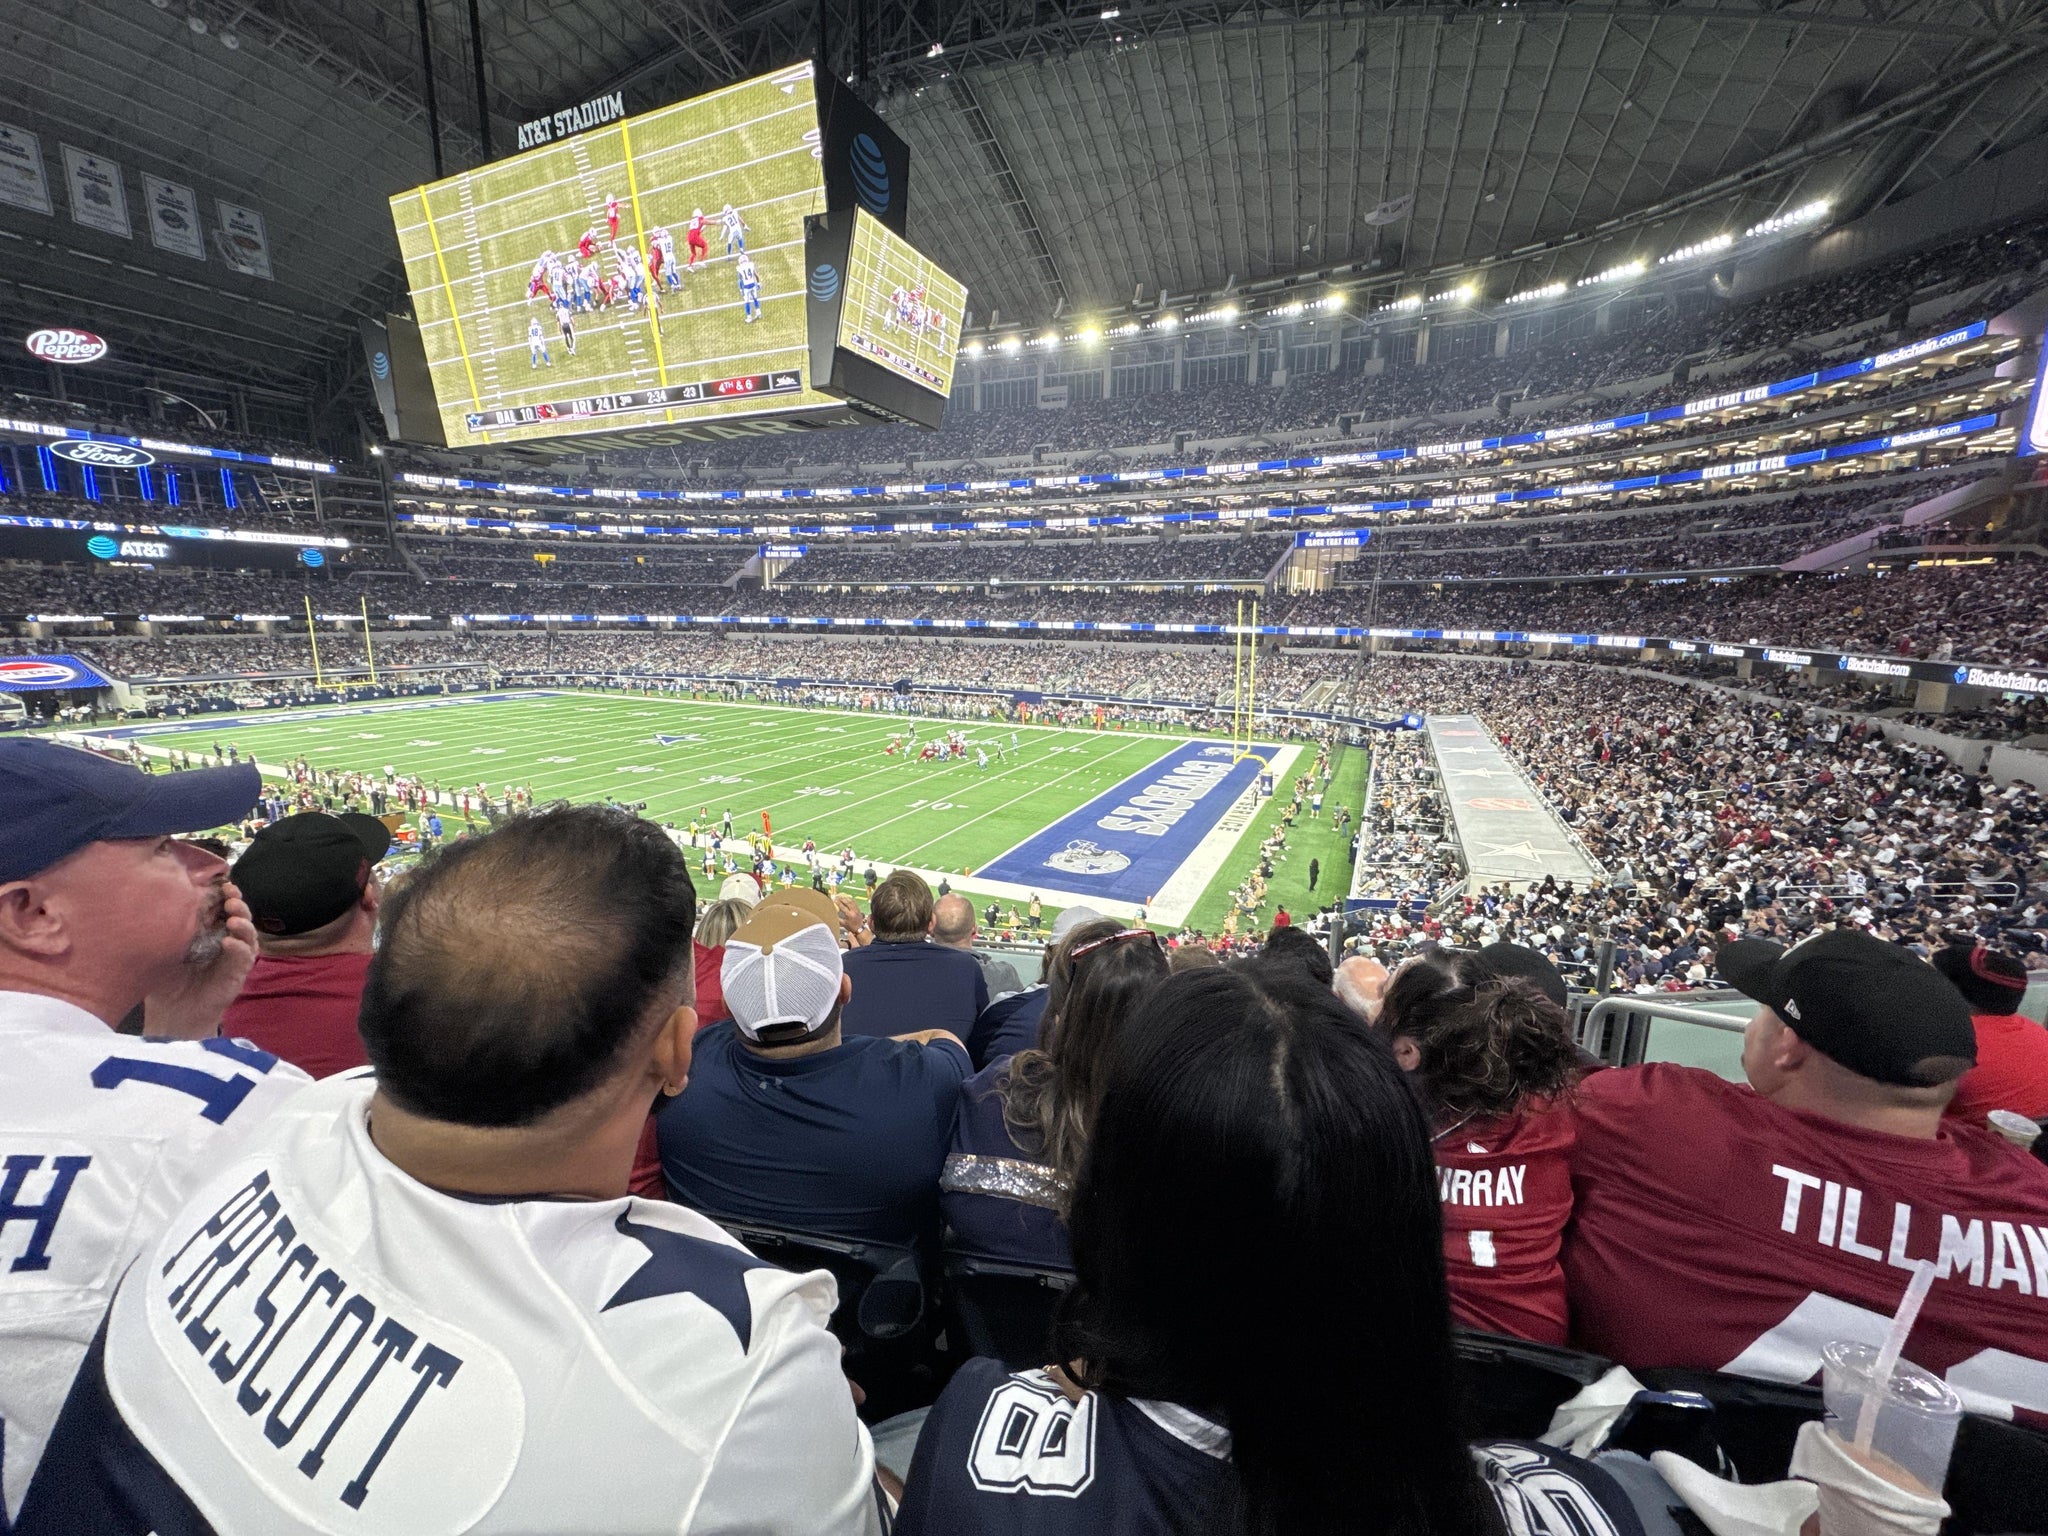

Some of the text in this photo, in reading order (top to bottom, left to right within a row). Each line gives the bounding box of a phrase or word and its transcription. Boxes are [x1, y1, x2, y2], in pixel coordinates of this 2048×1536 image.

[518, 91, 625, 149] AT&T STADIUM
[35, 330, 101, 359] Pepper
[57, 331, 87, 345] Dr
[1874, 331, 1967, 369] Blockchain.com
[719, 379, 753, 393] 4TH & 6
[572, 398, 610, 415] ARI 24
[647, 390, 667, 404] 2:34
[1685, 386, 1769, 415] BLOCK THAT KICK
[496, 408, 534, 425] DAL 10
[1545, 422, 1615, 440] Blockchain.com
[1890, 425, 1960, 447] Blockchain.com
[70, 443, 137, 465] Ford
[1321, 453, 1378, 465] Blockchain.com
[1702, 456, 1786, 479] BLOCK THAT KICK
[1561, 483, 1614, 495] Blockchain.com
[120, 541, 169, 558] AT&T
[1846, 657, 1910, 677] Blockchain.com
[1967, 668, 2048, 693] Blockchain.c
[1097, 760, 1236, 836] COWBOYS
[163, 1170, 464, 1510] PRESCOTT
